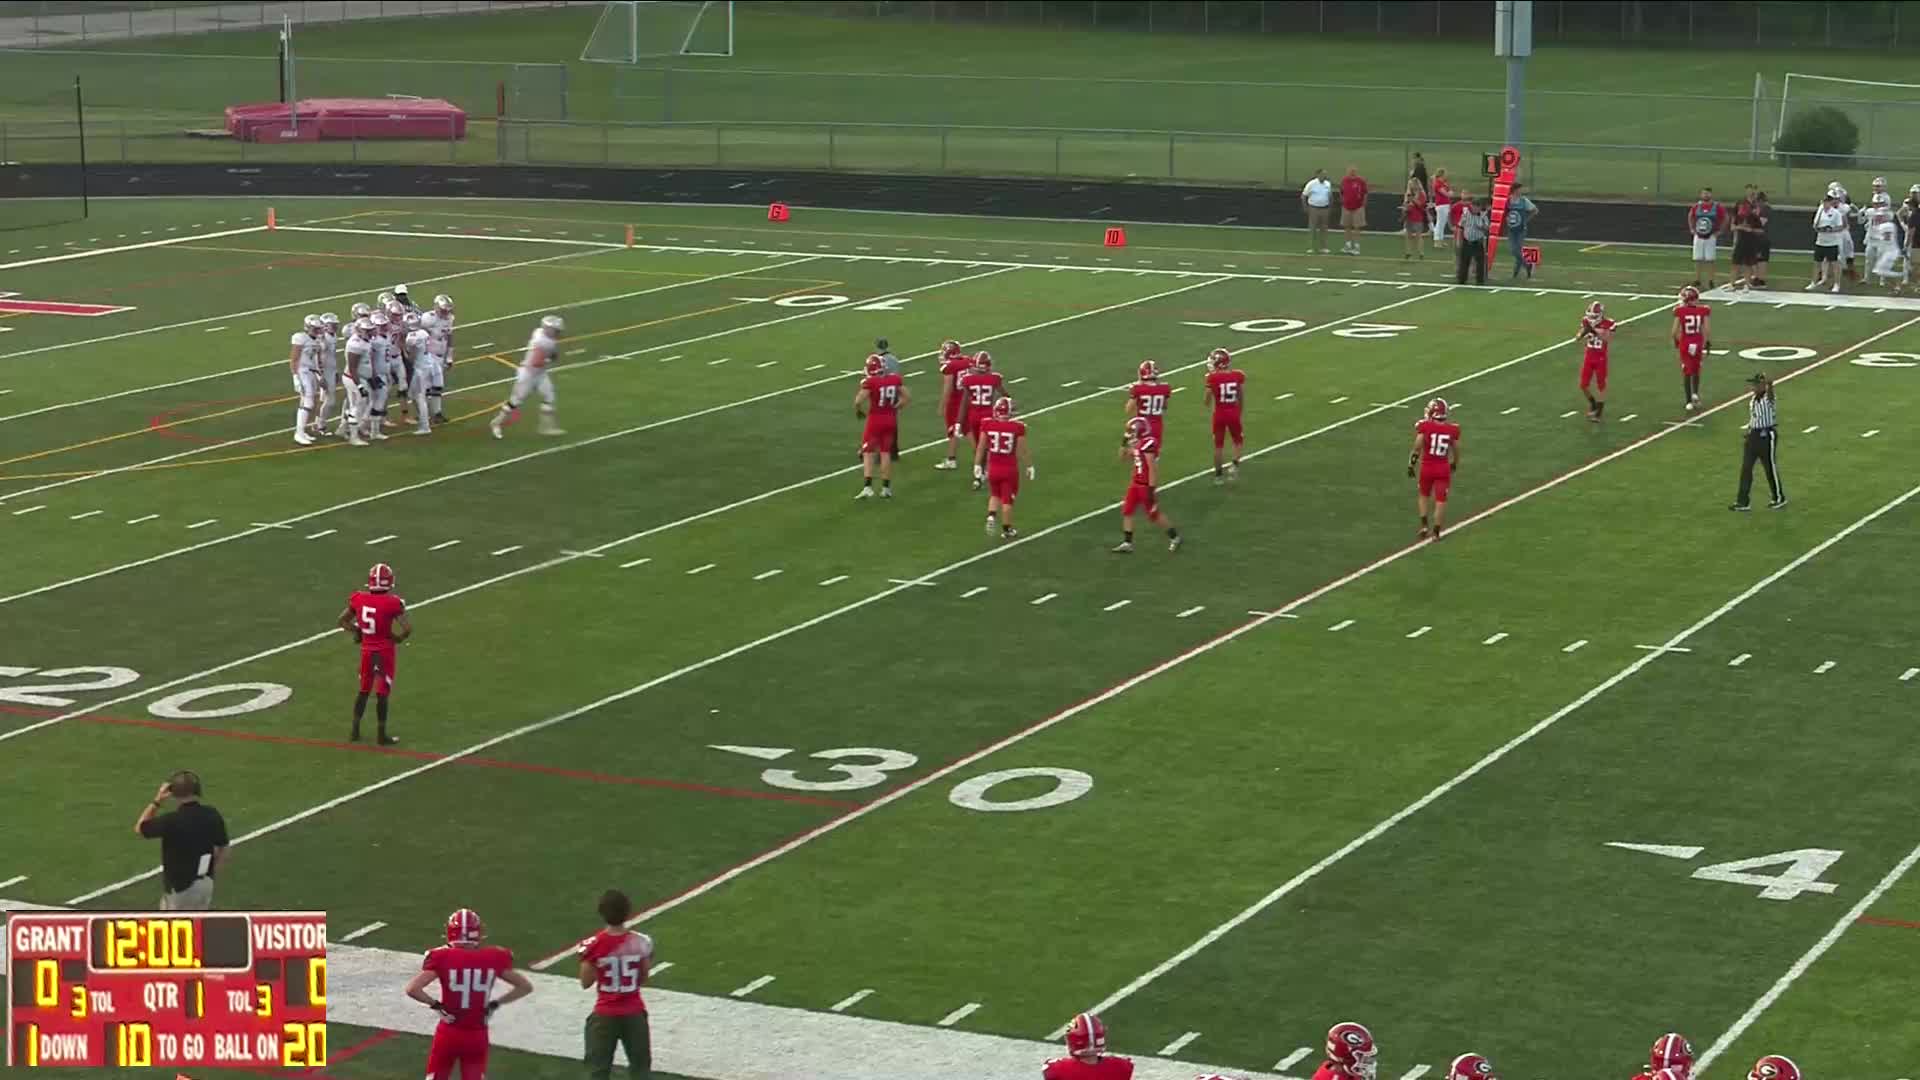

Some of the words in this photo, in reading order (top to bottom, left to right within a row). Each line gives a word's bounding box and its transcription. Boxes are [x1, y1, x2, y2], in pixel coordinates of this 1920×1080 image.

[1685, 315, 1701, 334] 21
[878, 385, 897, 407] 19
[969, 385, 993, 406] 32
[1219, 382, 1238, 403] 15
[1139, 395, 1165, 416] 30
[988, 431, 1015, 454] 33
[1429, 433, 1450, 456] 16
[361, 605, 377, 635] 5
[597, 954, 641, 993] 35
[449, 967, 495, 1009] 44
